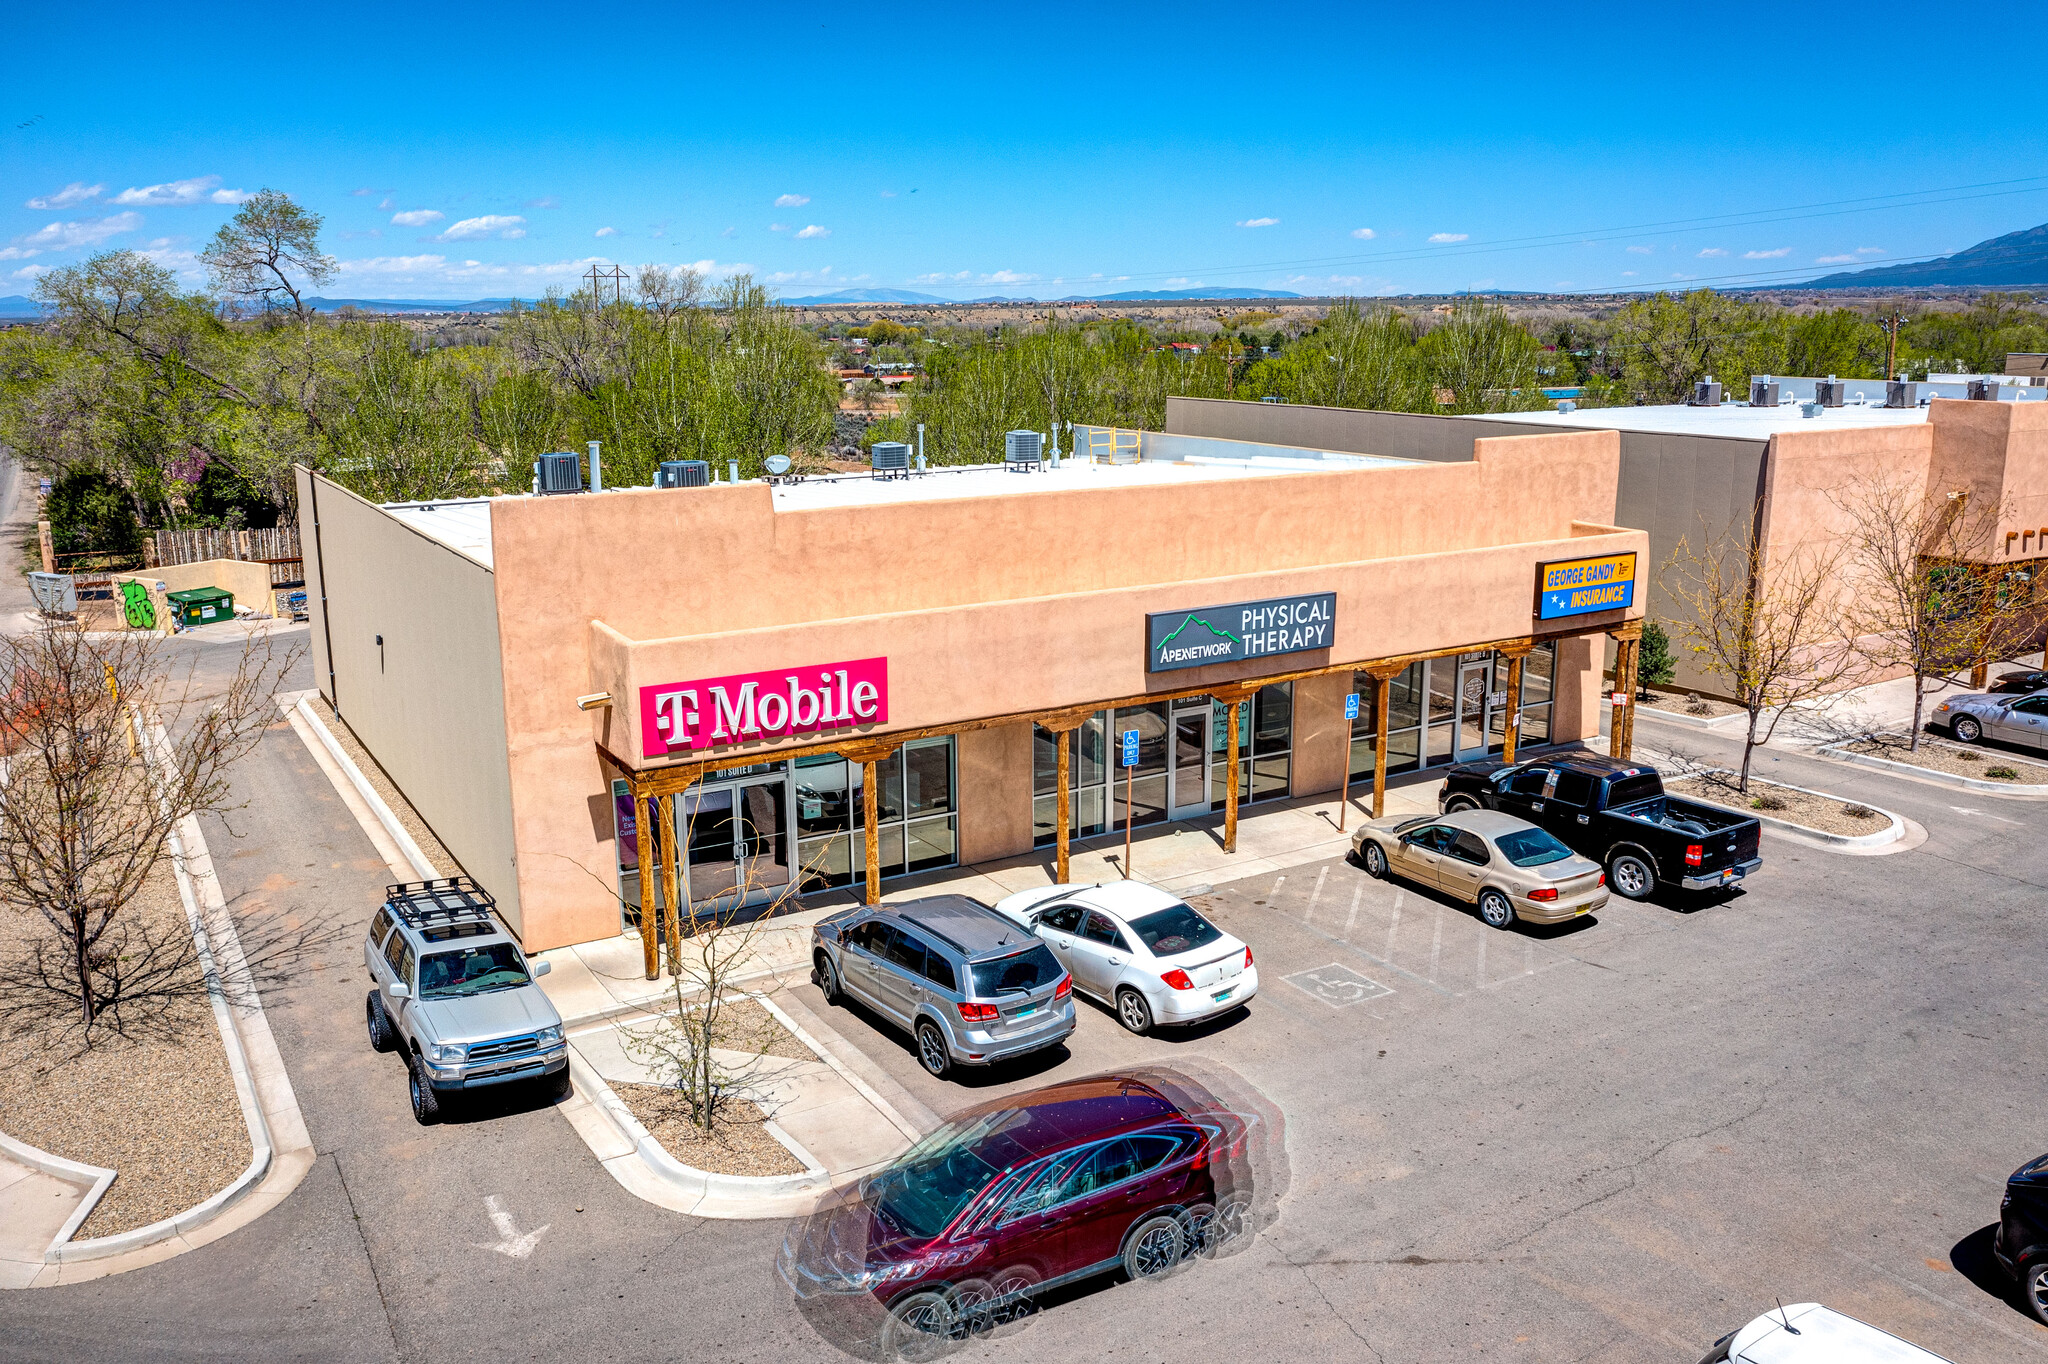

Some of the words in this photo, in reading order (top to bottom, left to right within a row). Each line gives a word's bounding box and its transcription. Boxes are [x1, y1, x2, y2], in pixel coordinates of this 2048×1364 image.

[1547, 566, 1585, 587] GEORGE
[1586, 563, 1616, 582] GANDY
[1570, 585, 1626, 608] INSURANCE
[1241, 600, 1331, 631] PHYSICAL
[1242, 623, 1327, 655] THERAPY
[708, 670, 879, 739] Mobile
[716, 769, 727, 778] 101
[728, 766, 747, 777] SUITE
